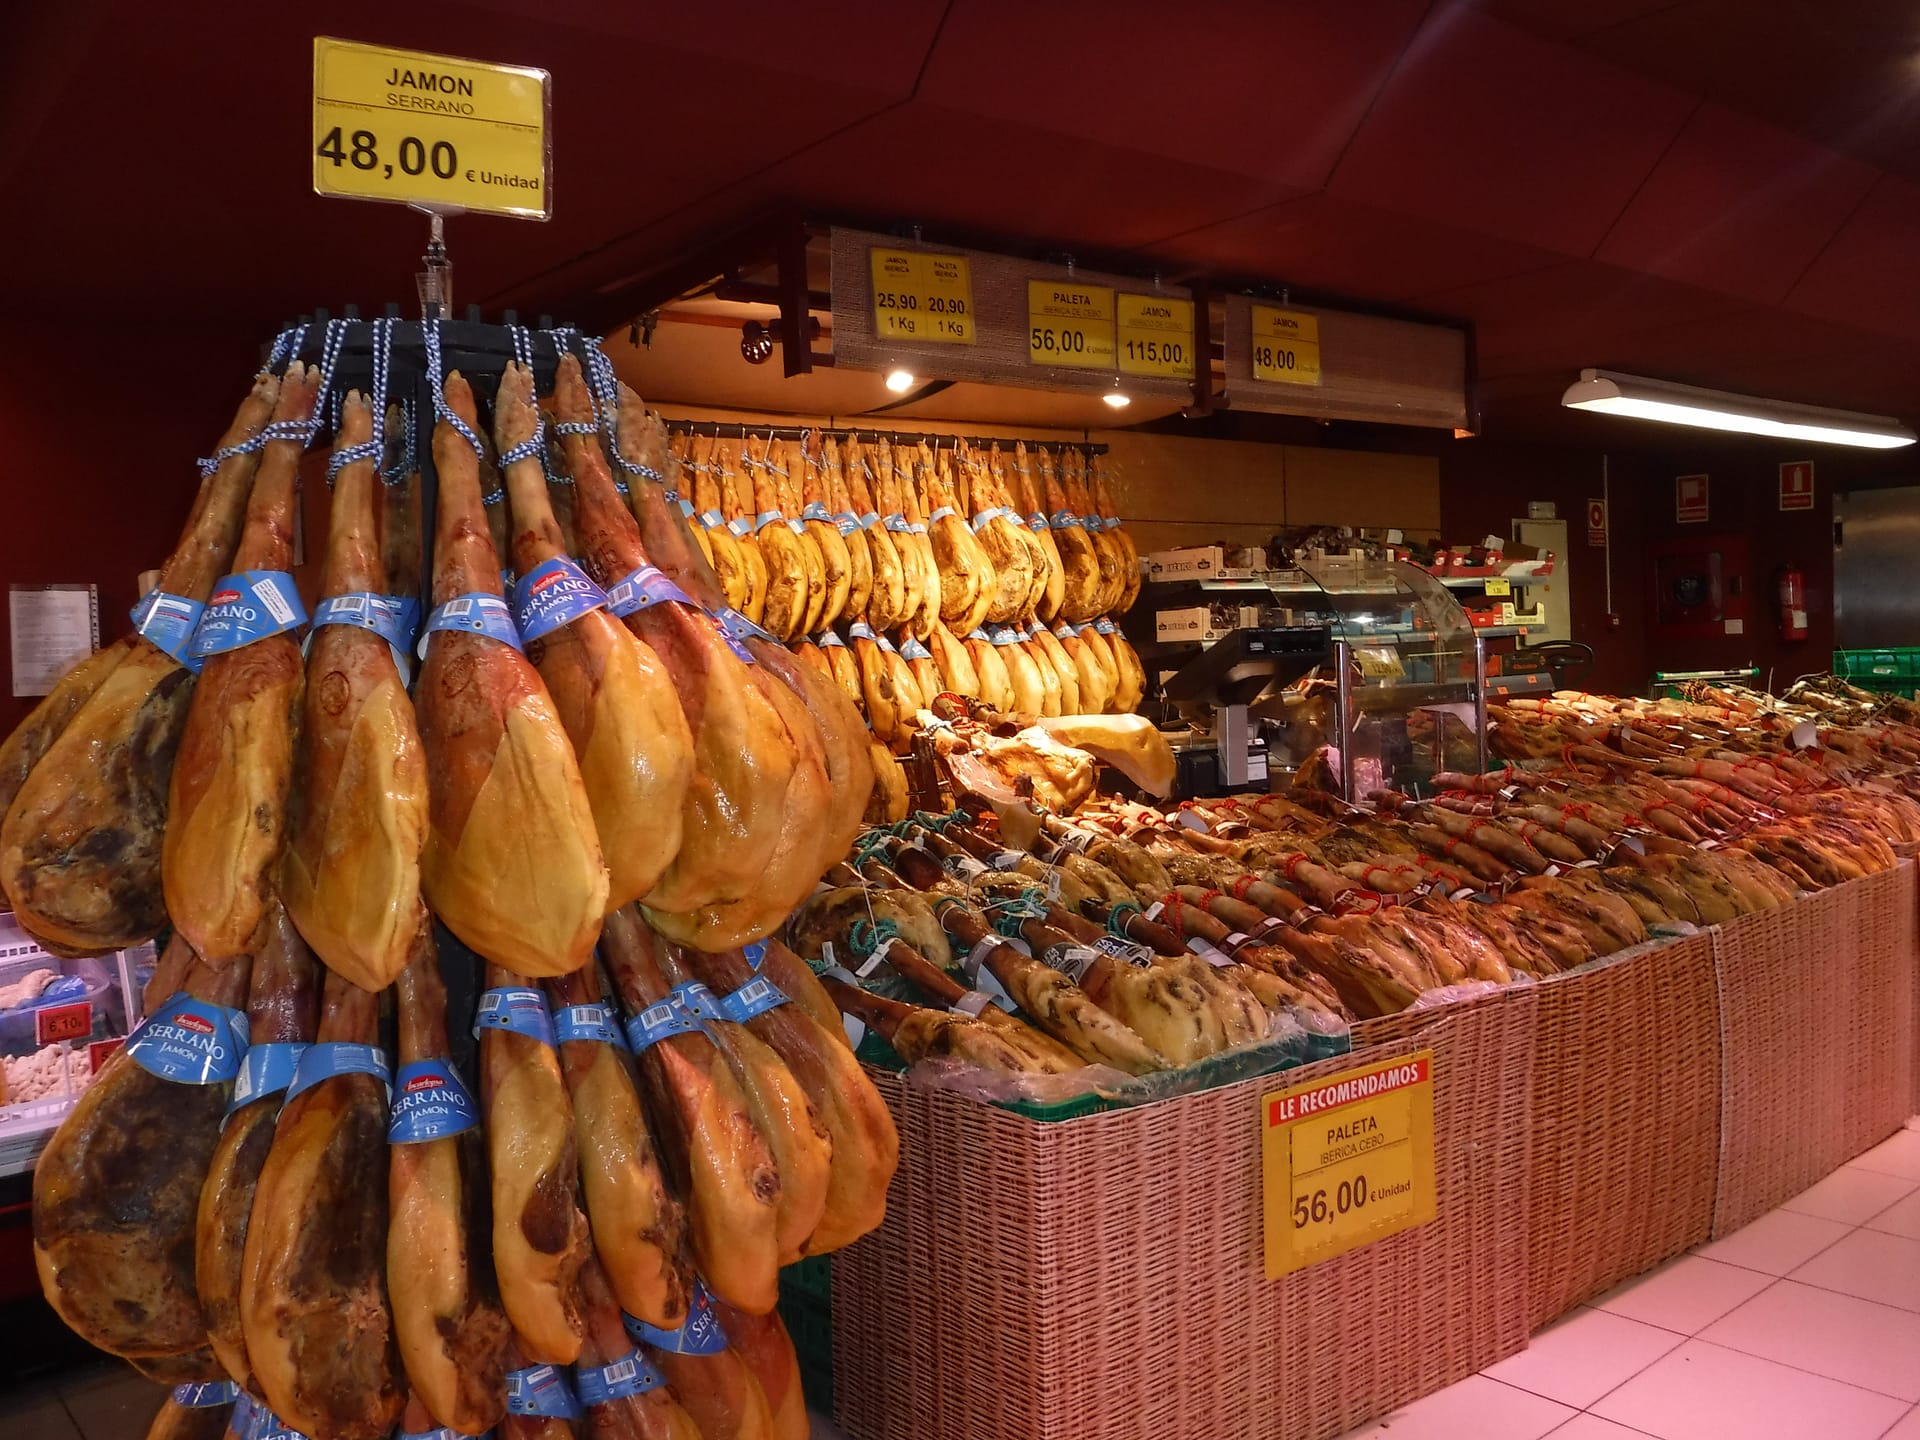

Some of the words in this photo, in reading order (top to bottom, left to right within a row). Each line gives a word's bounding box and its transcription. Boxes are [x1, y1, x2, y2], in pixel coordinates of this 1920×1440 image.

[386, 68, 473, 97] JAMON
[386, 93, 475, 115] SERRANO
[317, 126, 457, 180] 48,00
[465, 169, 476, 183] €
[481, 172, 539, 190] Unidad
[878, 293, 917, 311] 25,90
[928, 297, 965, 316] 20,90
[1054, 292, 1091, 305] PALETA
[1141, 306, 1171, 318] JAMON
[888, 316, 894, 329] 1
[898, 318, 915, 333] Kg
[938, 320, 944, 332] 1
[948, 321, 964, 337] Kg
[1031, 328, 1084, 355] 56,00
[1126, 340, 1182, 366] 115,00
[1256, 346, 1295, 372] 48,00
[521, 580, 591, 626] SERRANO
[540, 594, 574, 617] JAMON
[143, 1023, 225, 1060] SERRANO
[160, 1041, 198, 1061] JAMON
[162, 1064, 177, 1075] 12
[1279, 1098, 1295, 1121] LE
[1300, 1063, 1419, 1114] RECOMENDAMOS
[391, 1089, 465, 1122] SERRANO
[410, 1105, 449, 1121] JAMON
[425, 1125, 439, 1134] 12
[1327, 1115, 1378, 1145] PALETA
[1320, 1143, 1358, 1165] IBERICA
[1359, 1132, 1385, 1151] CEBO
[1294, 1174, 1368, 1229] 56,00
[1370, 1190, 1377, 1202] €
[1378, 1180, 1411, 1200] Unidad
